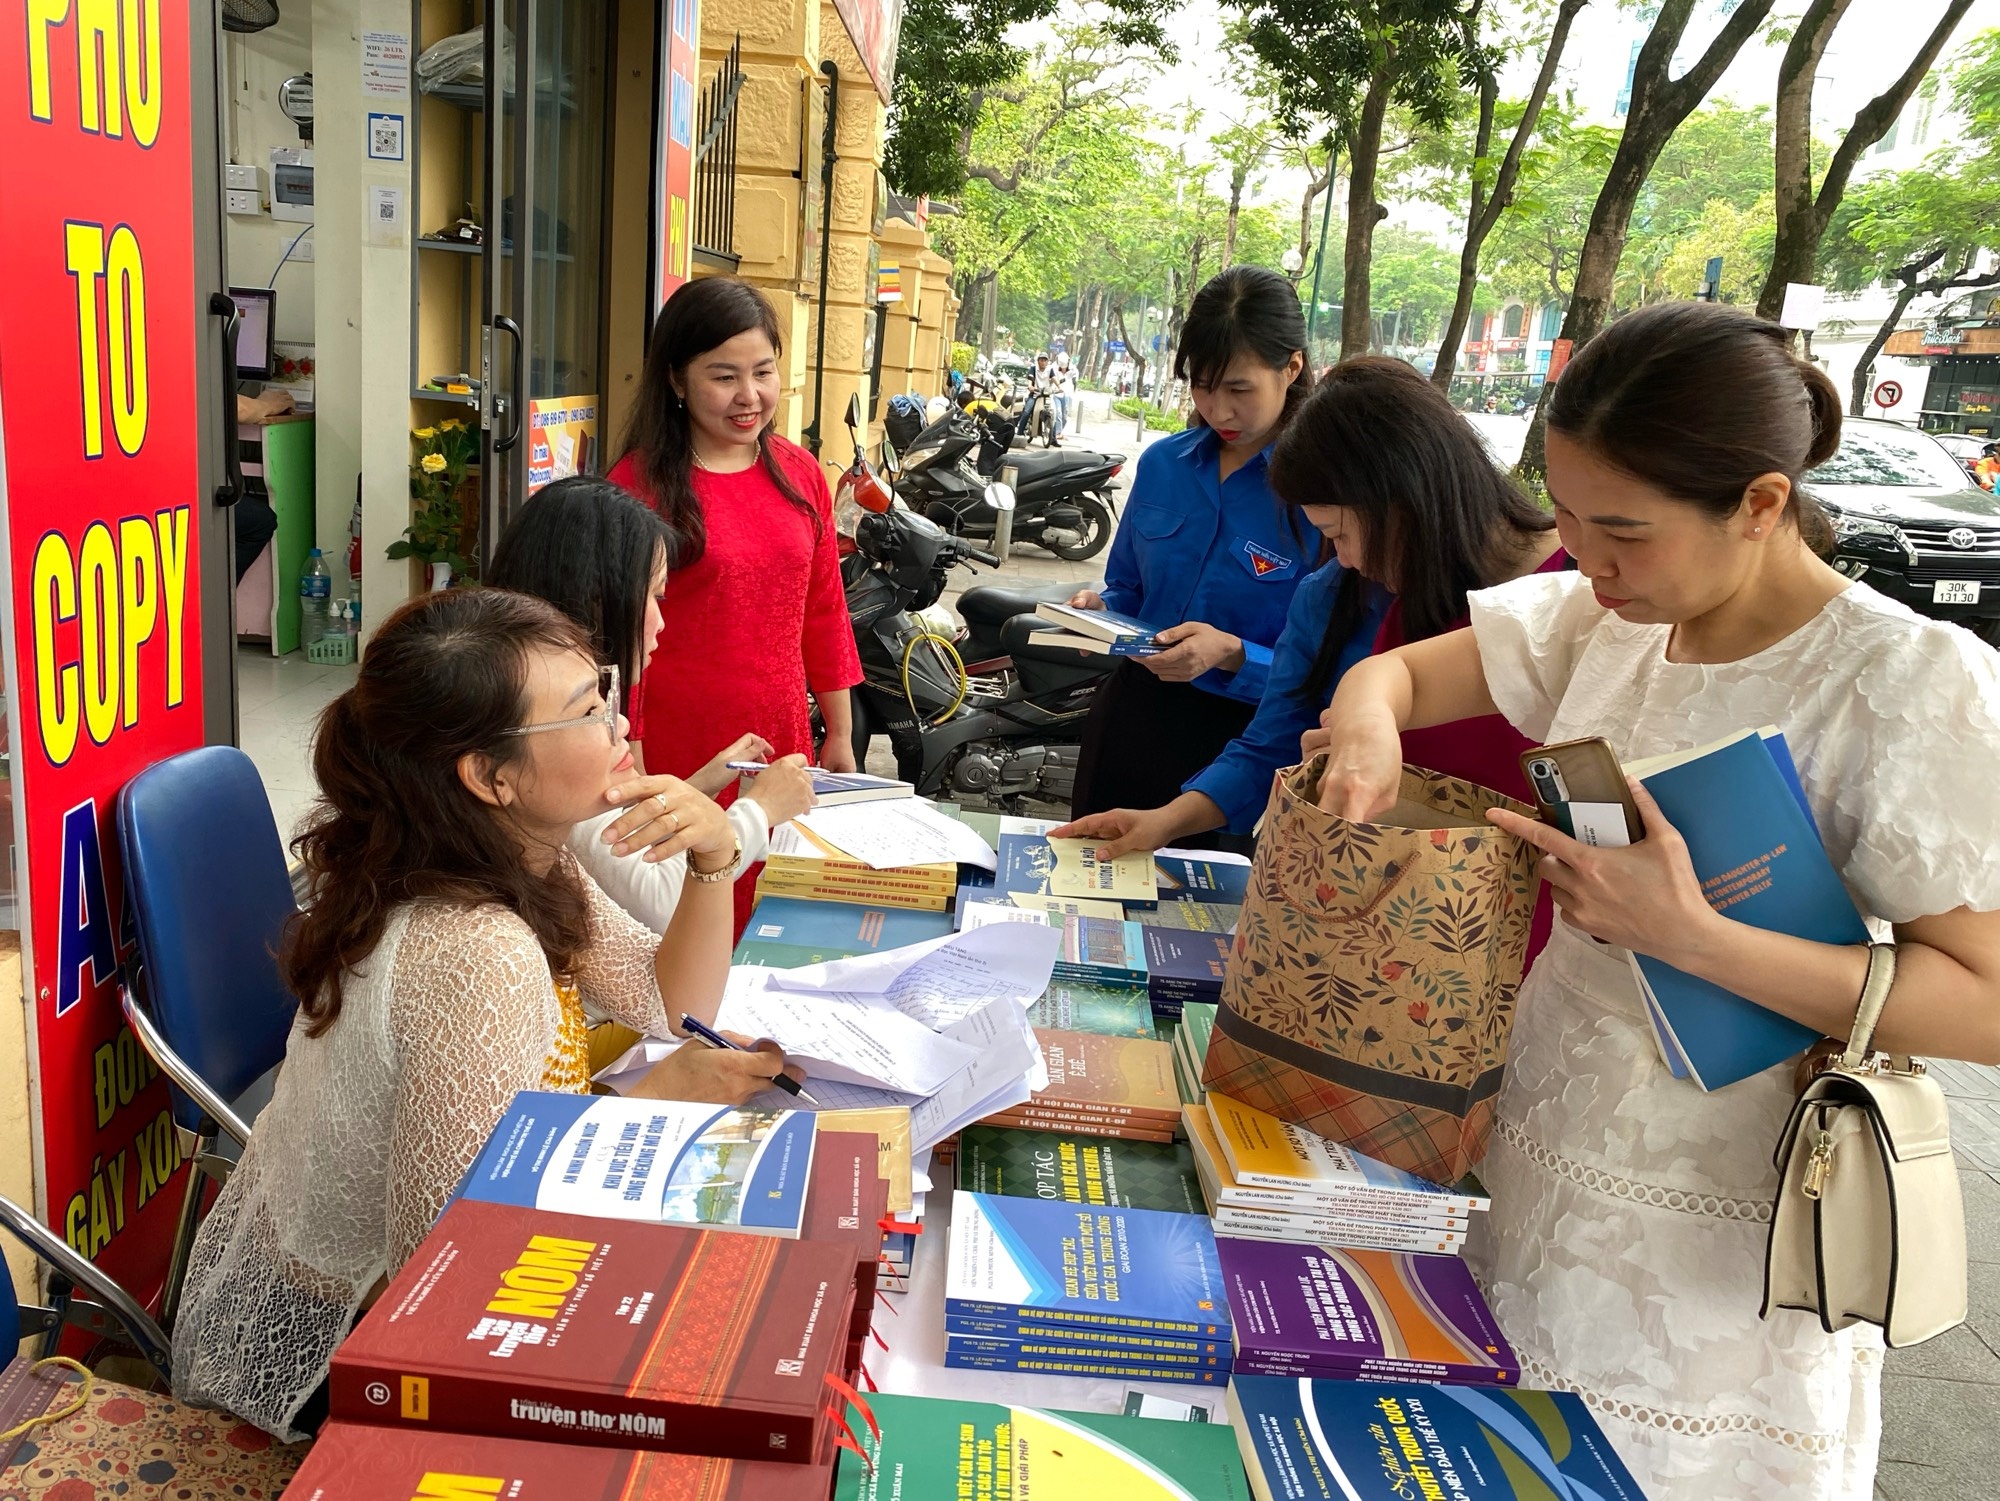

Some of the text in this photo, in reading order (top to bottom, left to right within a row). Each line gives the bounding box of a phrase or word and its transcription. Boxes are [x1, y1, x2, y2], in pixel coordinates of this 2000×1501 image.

[65, 219, 150, 459] TO
[1940, 593, 1974, 602] 131.30
[1948, 583, 1967, 592] 30K
[30, 505, 191, 767] COPY
[887, 720, 915, 730] YAMAHA
[57, 797, 140, 1018] A
[644, 1115, 670, 1134] RỘNG
[1043, 1099, 1060, 1107] HỘI
[1063, 1101, 1082, 1109] DÂN
[1085, 1104, 1108, 1112] GIAN
[1110, 1106, 1131, 1114] Ê-ĐÊ
[1051, 1122, 1071, 1130] DÂN
[1074, 1125, 1097, 1133] GIAN
[1099, 1127, 1120, 1135] Ê-ĐÊ
[136, 1110, 182, 1210] XO
[561, 1122, 600, 1183] AN NINH NGUỒN NƯỚC
[601, 1122, 641, 1189] KHU VỰC TIỂU VÙNG
[637, 1134, 661, 1147] MỞ
[620, 1179, 646, 1201] SÔNG
[1030, 1150, 1060, 1199] ỢP TÁC
[1060, 1237, 1078, 1297] QUAN HỆ HỢP TÁC
[1075, 1213, 1099, 1300] GIỮA VIỆT NAM VỚI MỘT SỐ
[1096, 1215, 1119, 1301] QUỐC GIA TRUNG ĐÔNG
[1116, 1215, 1131, 1273] GIAI ĐOẠN 2010-2020
[485, 1235, 597, 1319] NÔM
[545, 1243, 612, 1347] CÁC DÂN TỘC THIỂU SỐ VIỆT NAM
[467, 1316, 496, 1340] Tổng
[489, 1322, 530, 1358] truyện
[373, 1388, 383, 1399] 22
[511, 1399, 576, 1427] truyện
[579, 1409, 616, 1430] thơ
[618, 1411, 665, 1436] NÔM
[956, 1423, 975, 1496] VIỆT CỦA HỌC SINH
[975, 1439, 993, 1490] CÁC DÂN TỘC
[995, 1422, 1011, 1498] Ở TỈNH BÌNH PHƯỚC:
[1017, 1438, 1029, 1495] VÀ GIẢI PHÁP
[1366, 1422, 1420, 1500] Nghiên cứu
[1373, 1397, 1445, 1501] HUYẾT TRUNG QUỐC
[1406, 1397, 1463, 1489] NIÊN ĐẦU THẾ KỶ XXI
